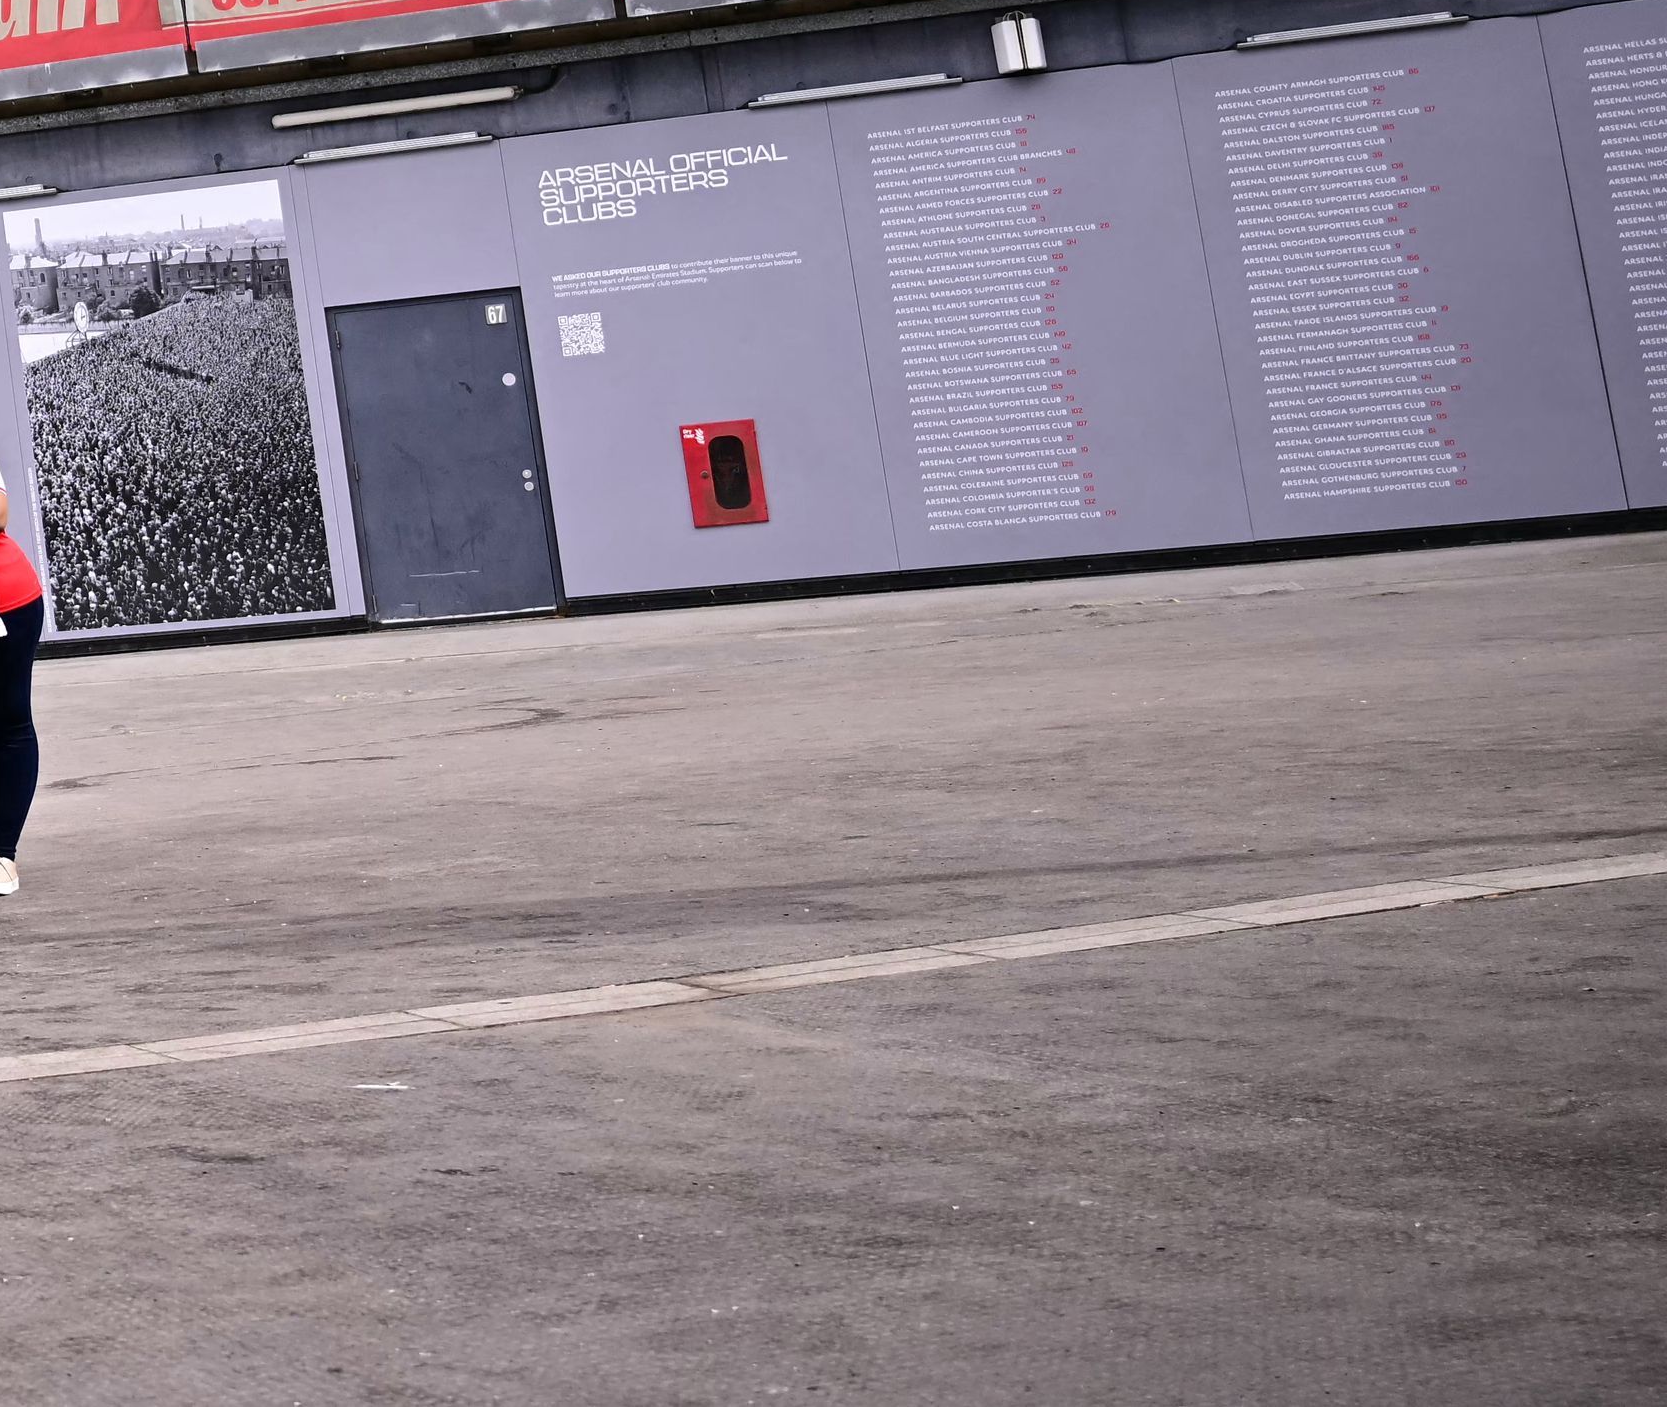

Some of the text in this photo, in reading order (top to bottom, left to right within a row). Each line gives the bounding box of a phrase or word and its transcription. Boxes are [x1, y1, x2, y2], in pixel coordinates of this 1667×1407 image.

[1215, 87, 1251, 97] ARSENAL
[1253, 83, 1288, 93] COUNTY
[1328, 72, 1381, 84] SUPPORTERS
[1382, 69, 1404, 78] CLUB
[867, 129, 901, 139] ARSENAL
[918, 123, 949, 133] BELFAST
[951, 117, 1000, 129] SUPPORTERS
[1002, 115, 1022, 123] CLUB
[538, 143, 787, 189] ARSENAL OFFICIAL
[540, 169, 729, 207] SUPPORTERS
[542, 200, 637, 226] CLUBS
[487, 305, 505, 323] 67
[1264, 372, 1301, 381] ARSENAL
[1303, 369, 1336, 378] FRANCE
[1379, 360, 1433, 371] SUPPORTERS
[1434, 358, 1457, 366] CLUB
